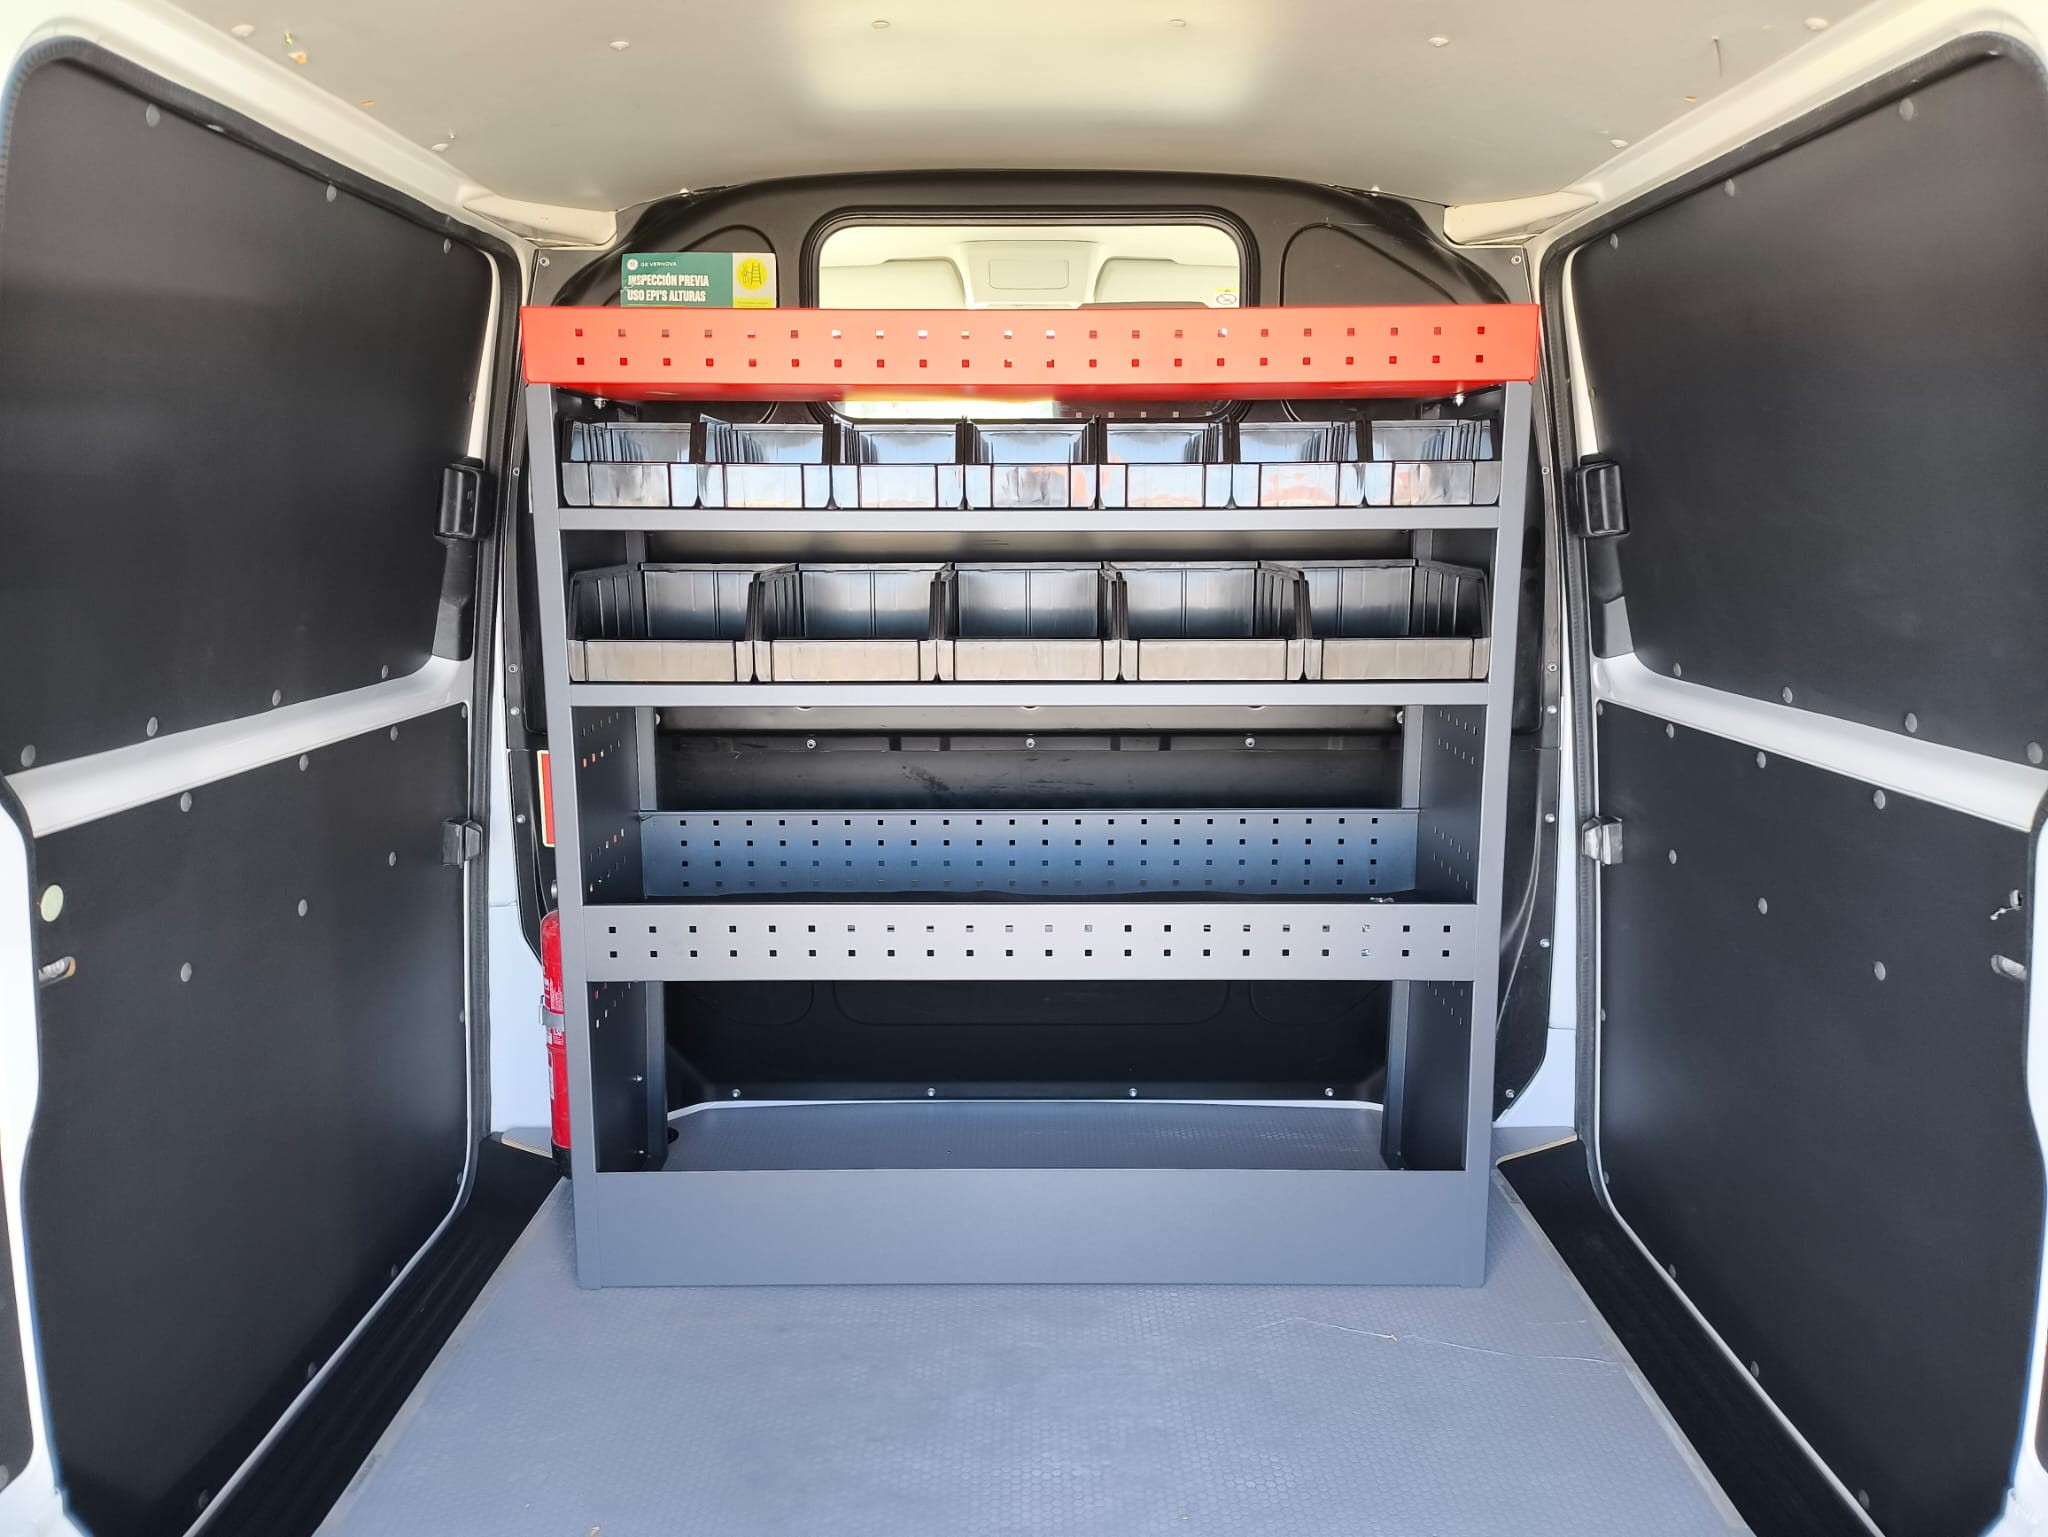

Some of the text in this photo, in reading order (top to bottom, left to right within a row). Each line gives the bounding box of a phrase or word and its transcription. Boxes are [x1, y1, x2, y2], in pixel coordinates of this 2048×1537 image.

[628, 272, 709, 287] INSPECCIÓN PREVIA
[627, 289, 706, 302] USO EPI'S ALTURAS
